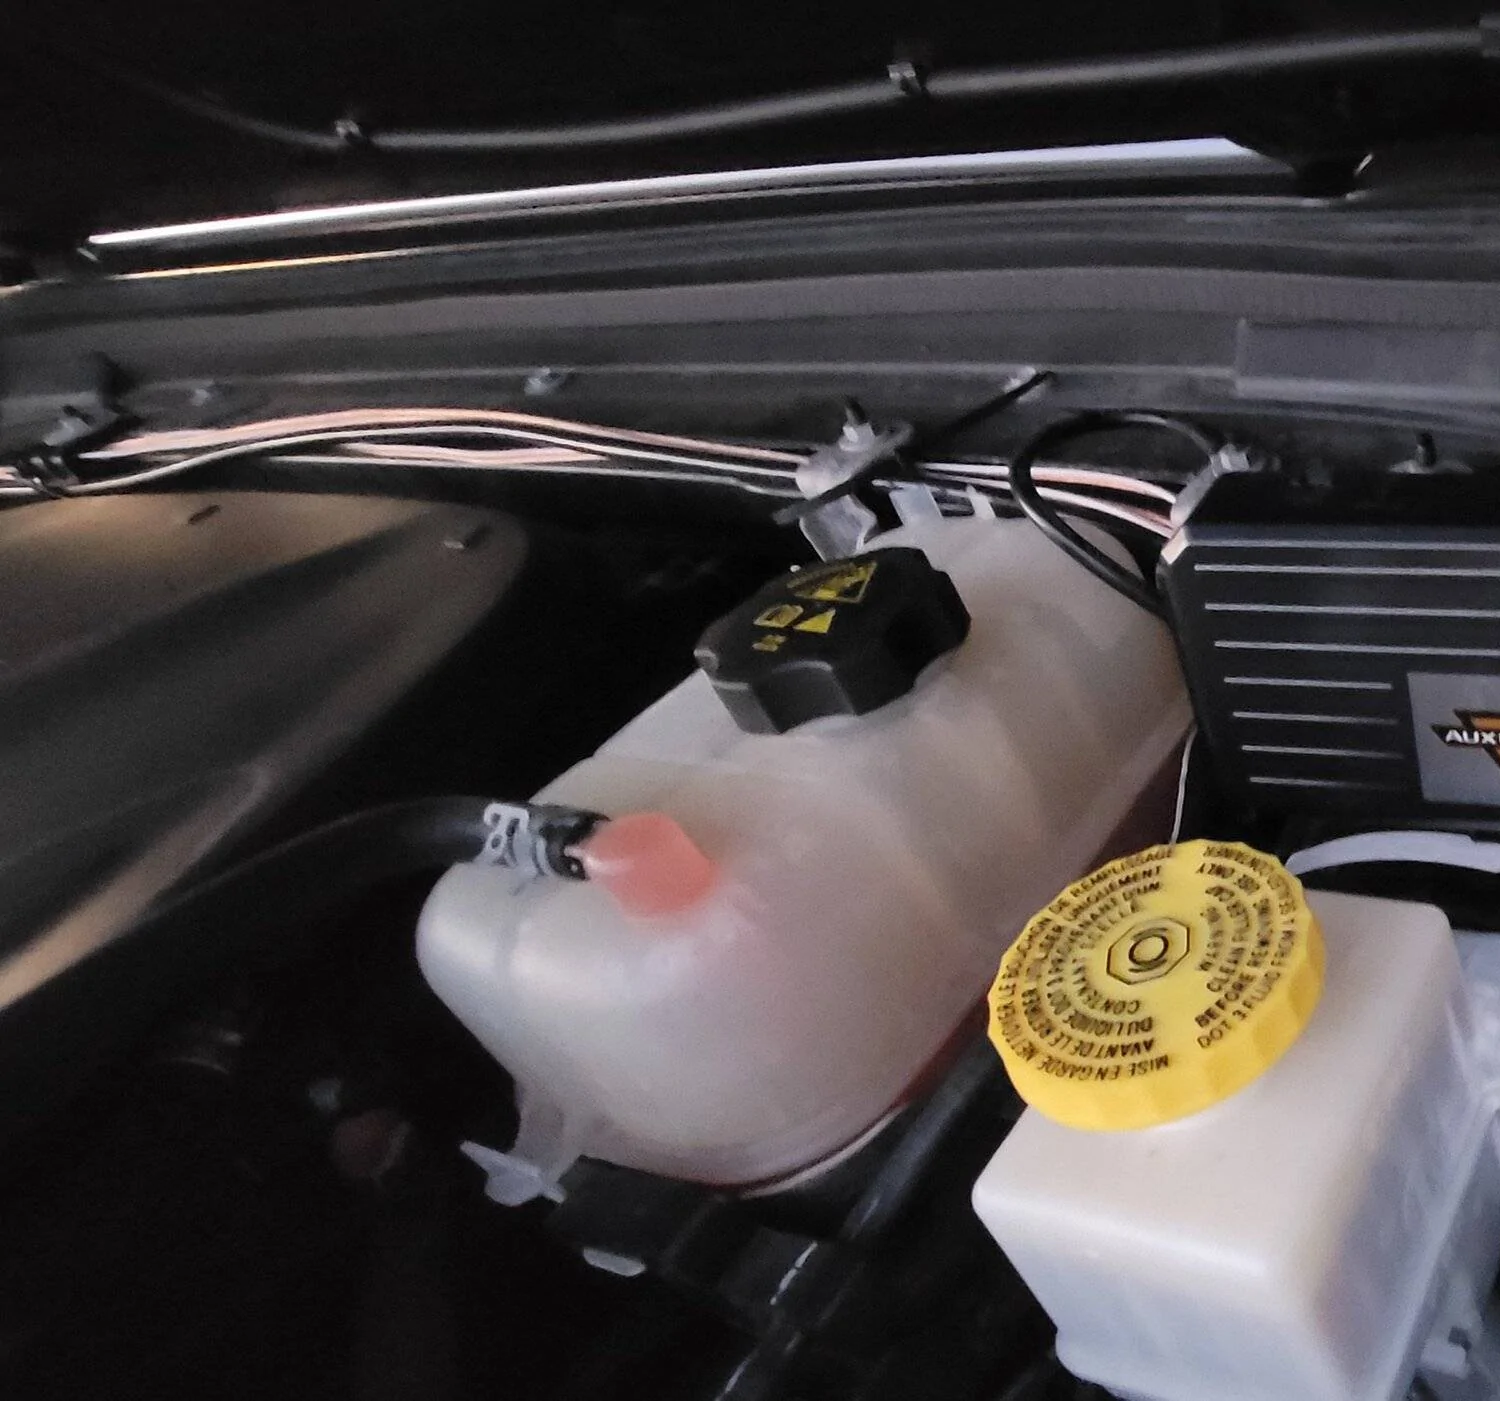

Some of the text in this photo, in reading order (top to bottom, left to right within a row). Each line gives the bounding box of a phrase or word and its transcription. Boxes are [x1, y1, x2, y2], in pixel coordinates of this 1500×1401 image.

[1194, 1018, 1235, 1050] DOT
[1229, 1007, 1249, 1022] 3
[1045, 1030, 1074, 1051] LE
[1093, 1037, 1154, 1059] AVANT
[1035, 1054, 1094, 1080] GARDE
[1092, 1065, 1121, 1080] EN
[1126, 1053, 1169, 1077] MISE
